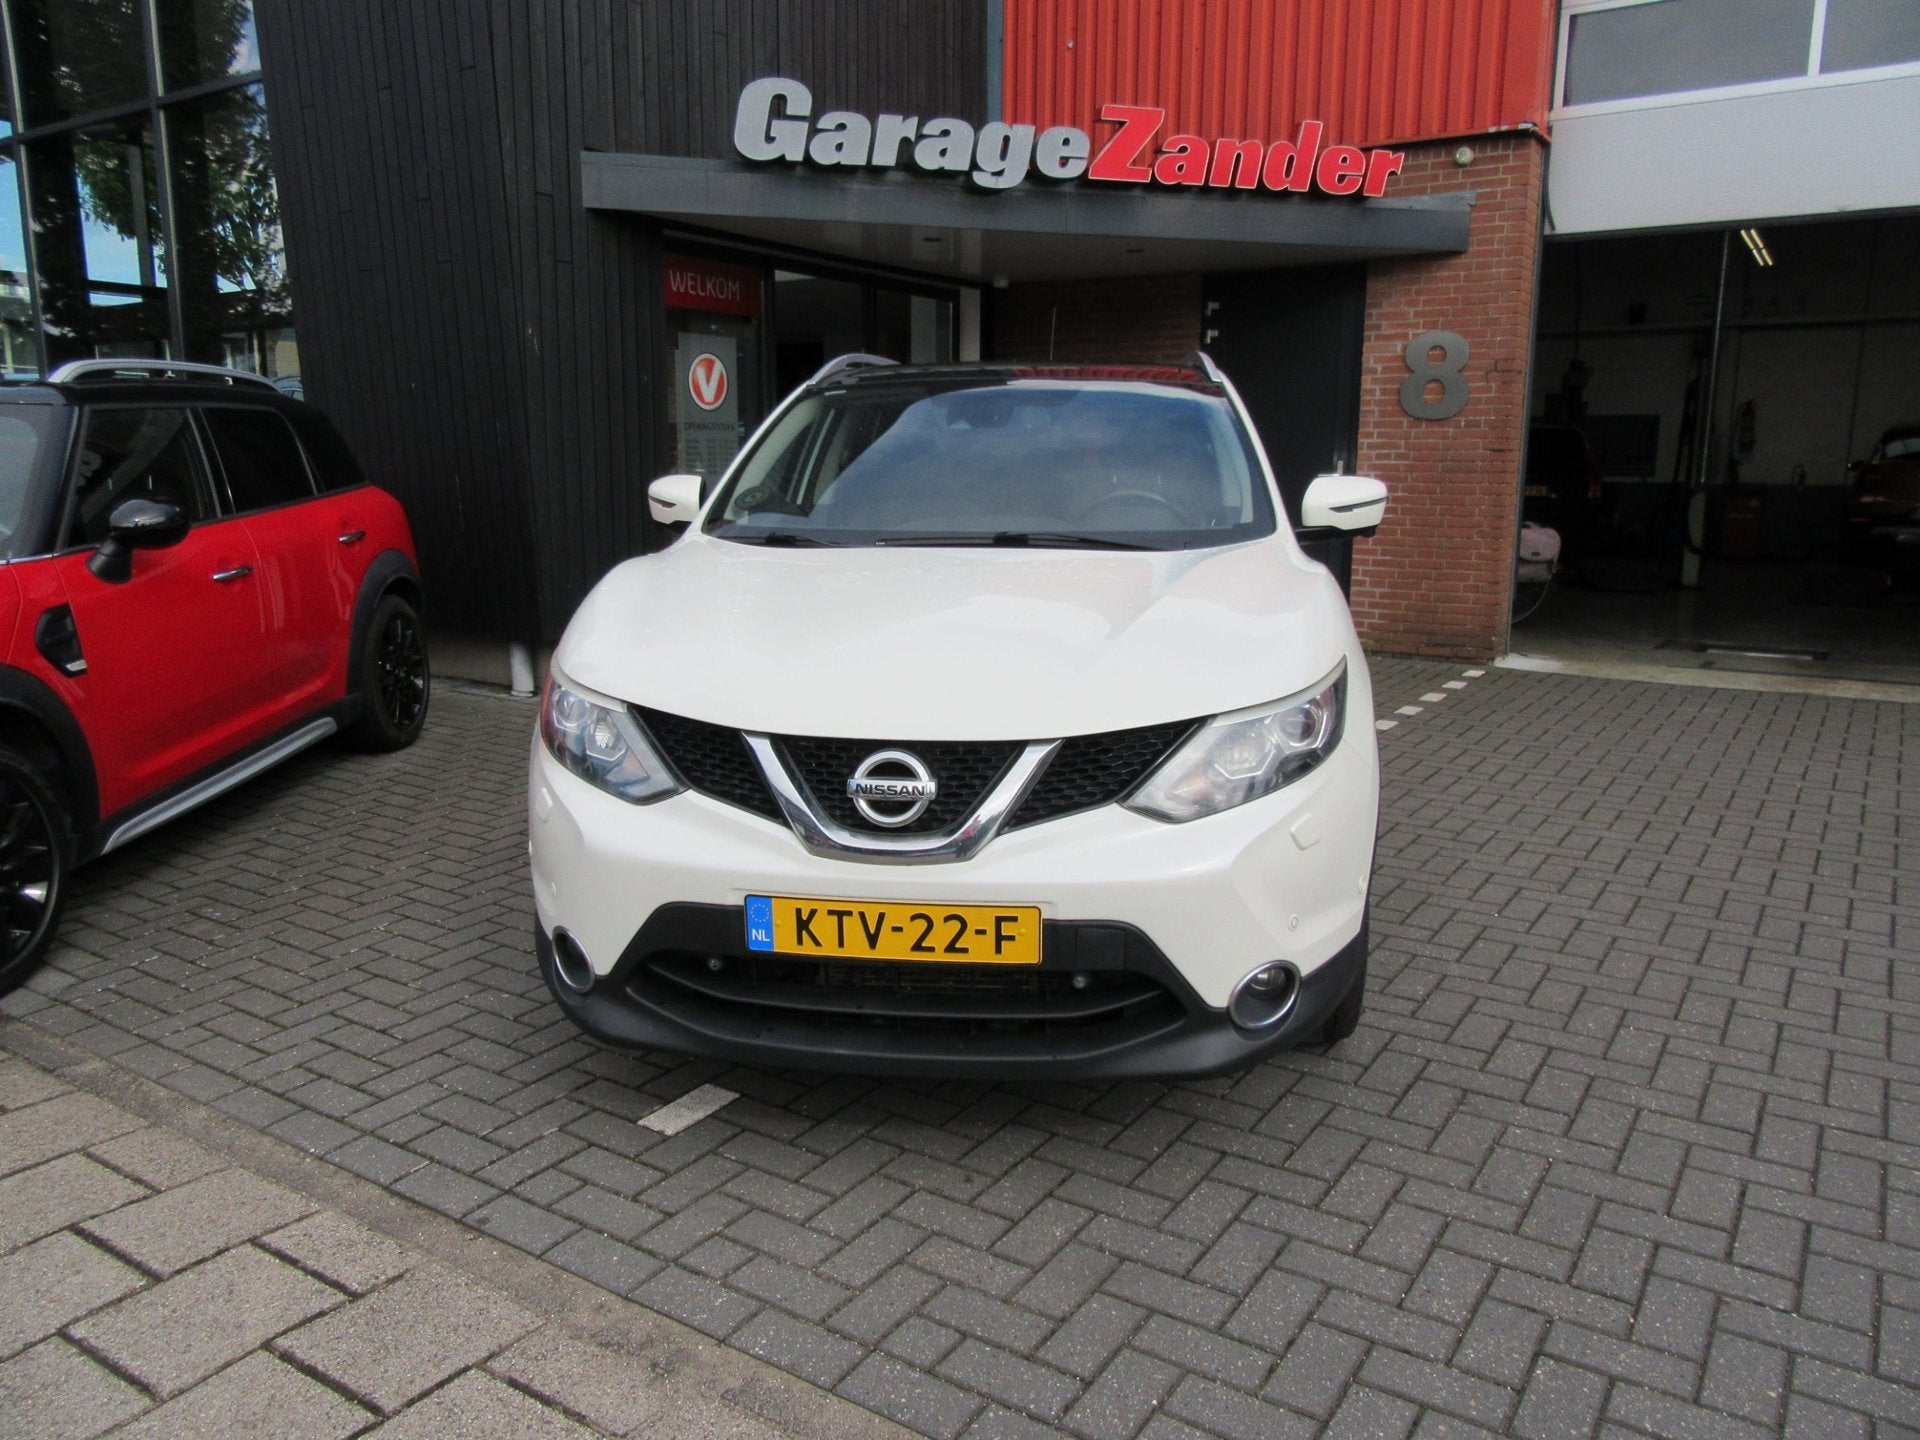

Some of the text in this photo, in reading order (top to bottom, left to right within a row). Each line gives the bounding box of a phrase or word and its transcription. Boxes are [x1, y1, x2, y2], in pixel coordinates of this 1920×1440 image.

[669, 270, 740, 301] WELKOM
[1399, 329, 1470, 420] 8
[856, 783, 925, 797] NISSAN
[752, 929, 770, 942] NL
[795, 907, 1019, 955] KTV-22-F
